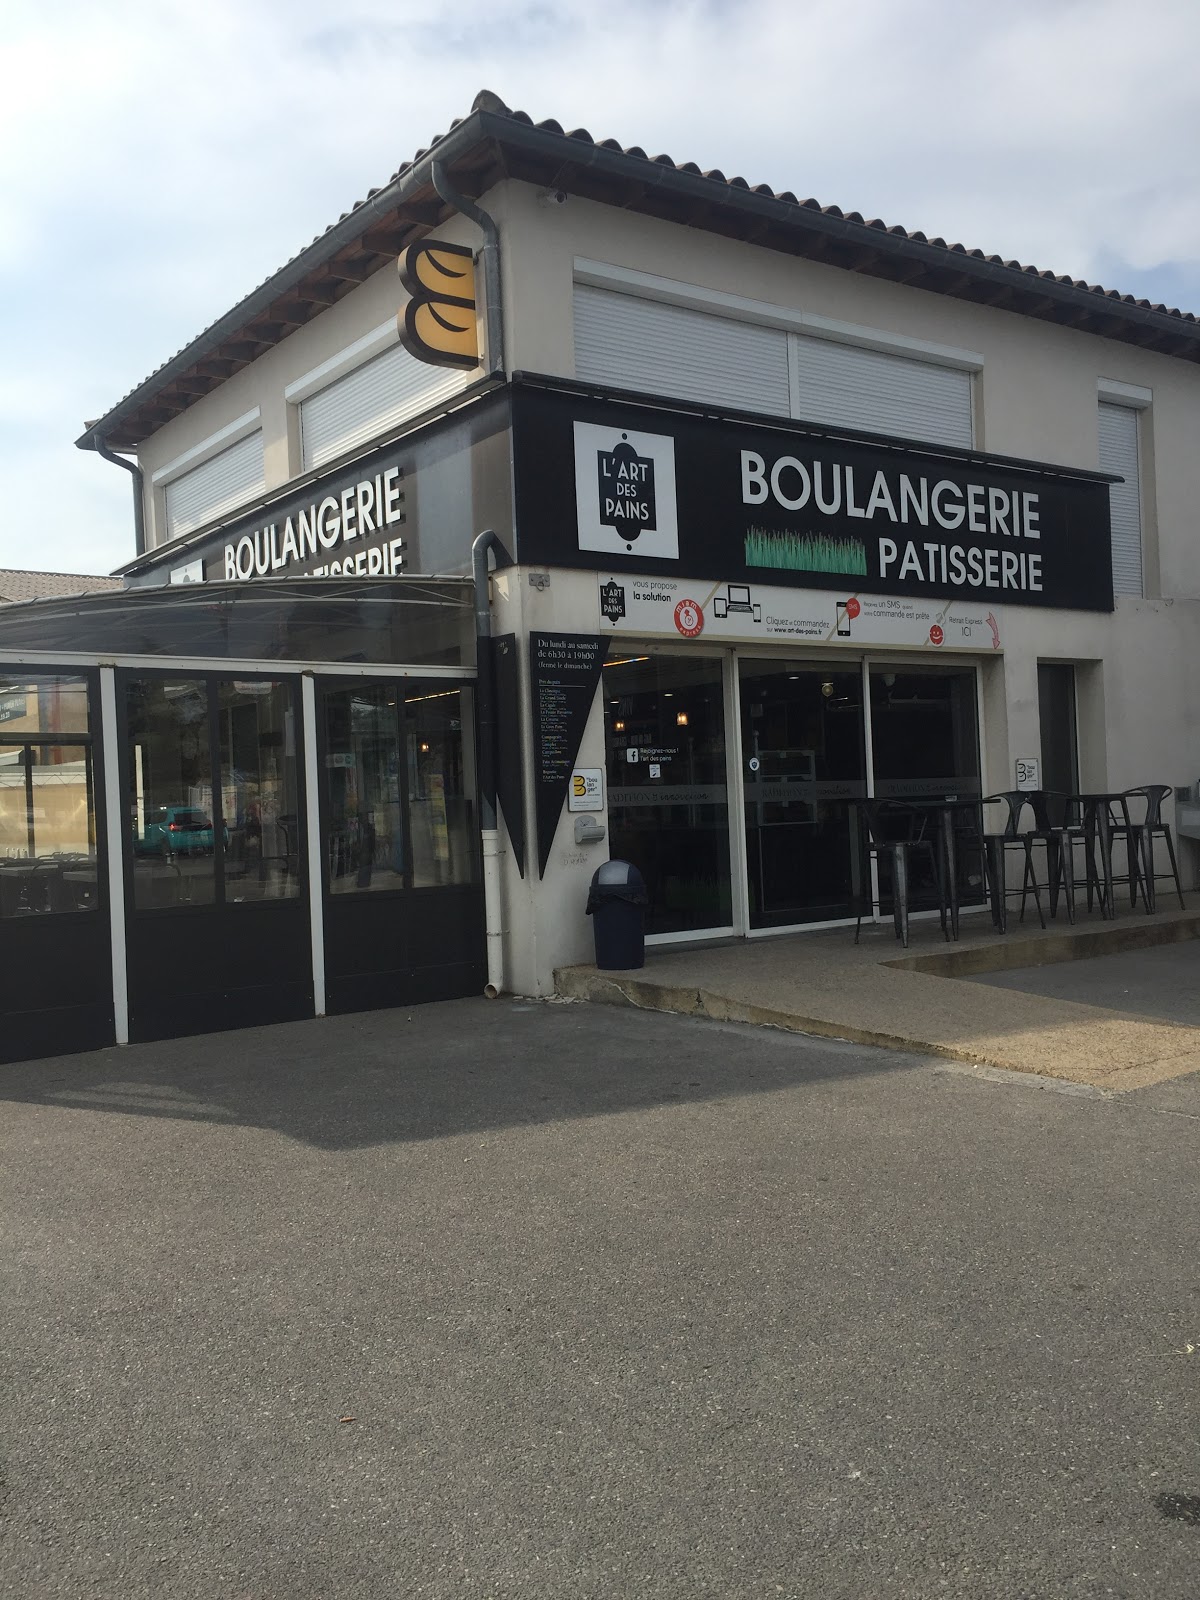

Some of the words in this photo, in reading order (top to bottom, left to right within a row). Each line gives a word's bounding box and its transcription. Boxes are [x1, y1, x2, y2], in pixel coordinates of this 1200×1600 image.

[602, 457, 649, 482] L'ART
[616, 482, 638, 498] DES
[741, 449, 1041, 539] BOULANGERIE
[605, 497, 650, 521] PAINS
[224, 465, 402, 581] BOULANGERIE
[878, 538, 1042, 591] PATISSERIE
[650, 582, 678, 592] propose
[602, 588, 623, 600] L'ART
[633, 590, 641, 601] la
[642, 592, 672, 603] solution
[603, 604, 624, 615] PAINS
[886, 600, 901, 609] SMS
[873, 610, 905, 618] commande
[765, 615, 789, 626] Cliquez
[793, 619, 830, 629] commandez
[961, 626, 972, 637] ICI
[537, 639, 549, 648] Du
[549, 639, 567, 649] lundi
[576, 641, 599, 651] samedi
[537, 649, 546, 659] de
[547, 650, 566, 659] 6h30
[573, 651, 595, 661] 19h00
[557, 661, 563, 669] le
[563, 661, 592, 671] dimanche)
